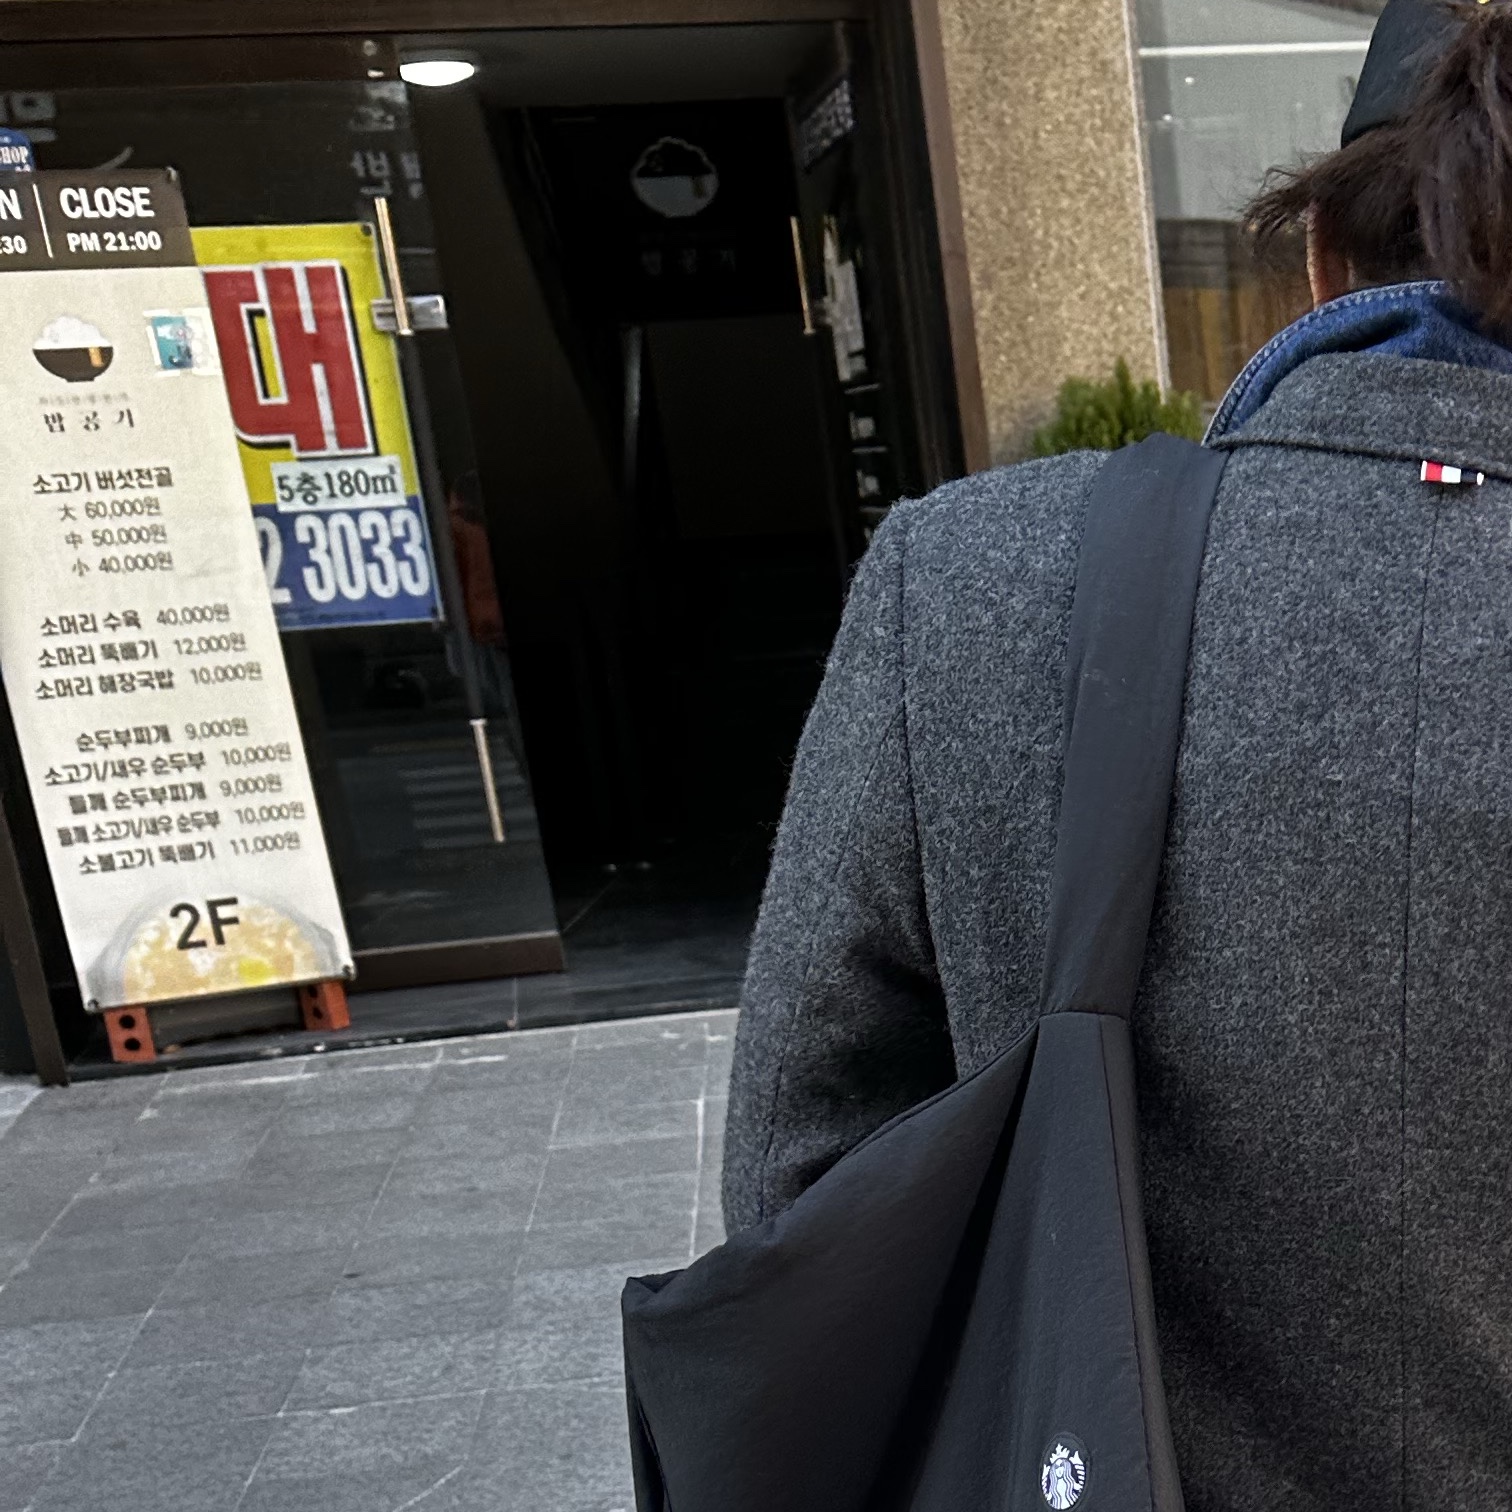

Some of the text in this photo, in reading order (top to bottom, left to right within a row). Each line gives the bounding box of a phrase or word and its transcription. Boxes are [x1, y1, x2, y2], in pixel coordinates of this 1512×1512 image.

[59, 187, 155, 219] CLOSE
[66, 231, 162, 252] PM 21:00
[33, 466, 174, 494] 소고기 버섯전골
[85, 496, 162, 520] 60,000원
[295, 508, 430, 603] 3033
[40, 603, 230, 636] 소머리 수육 40,000원
[38, 644, 96, 669] 소머리
[173, 632, 247, 656] 12,000원
[36, 676, 93, 700] 소머리
[190, 661, 263, 685] 10,000원
[185, 717, 249, 740] 9,000원
[151, 751, 206, 776] 순두부
[222, 742, 292, 767] 10,000원
[219, 773, 283, 798] 9,000원
[235, 801, 305, 825] 10,000원
[230, 831, 301, 856] 11,000원
[169, 896, 240, 951] 2F
